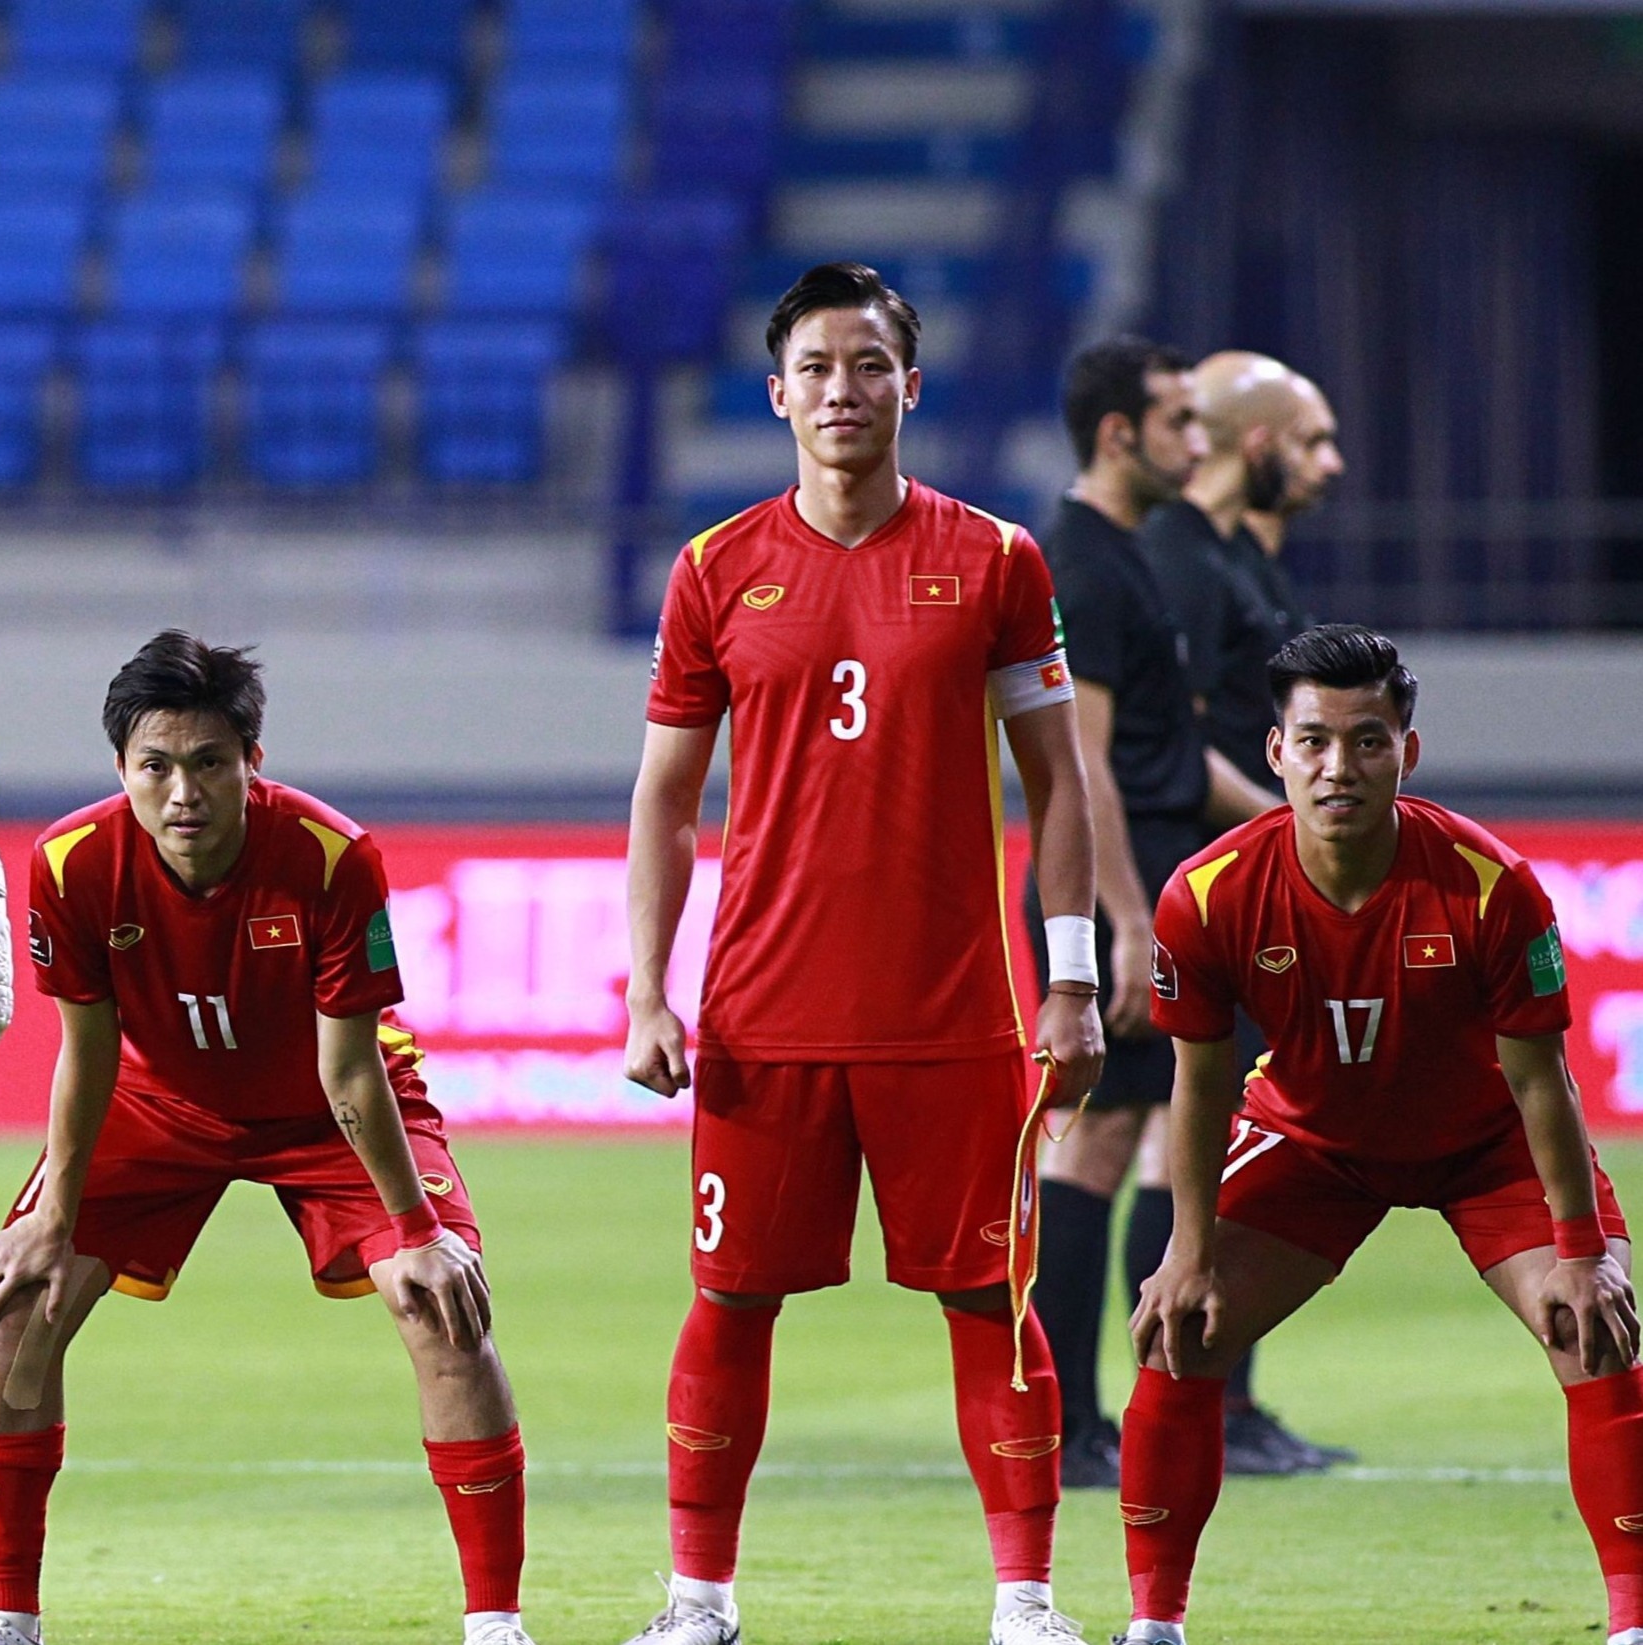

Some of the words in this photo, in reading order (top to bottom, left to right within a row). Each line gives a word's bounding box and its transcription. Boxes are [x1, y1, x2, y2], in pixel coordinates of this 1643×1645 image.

[829, 659, 867, 740] 3
[177, 992, 238, 1049] 11
[1324, 997, 1384, 1064] 17
[695, 1172, 726, 1253] 3
